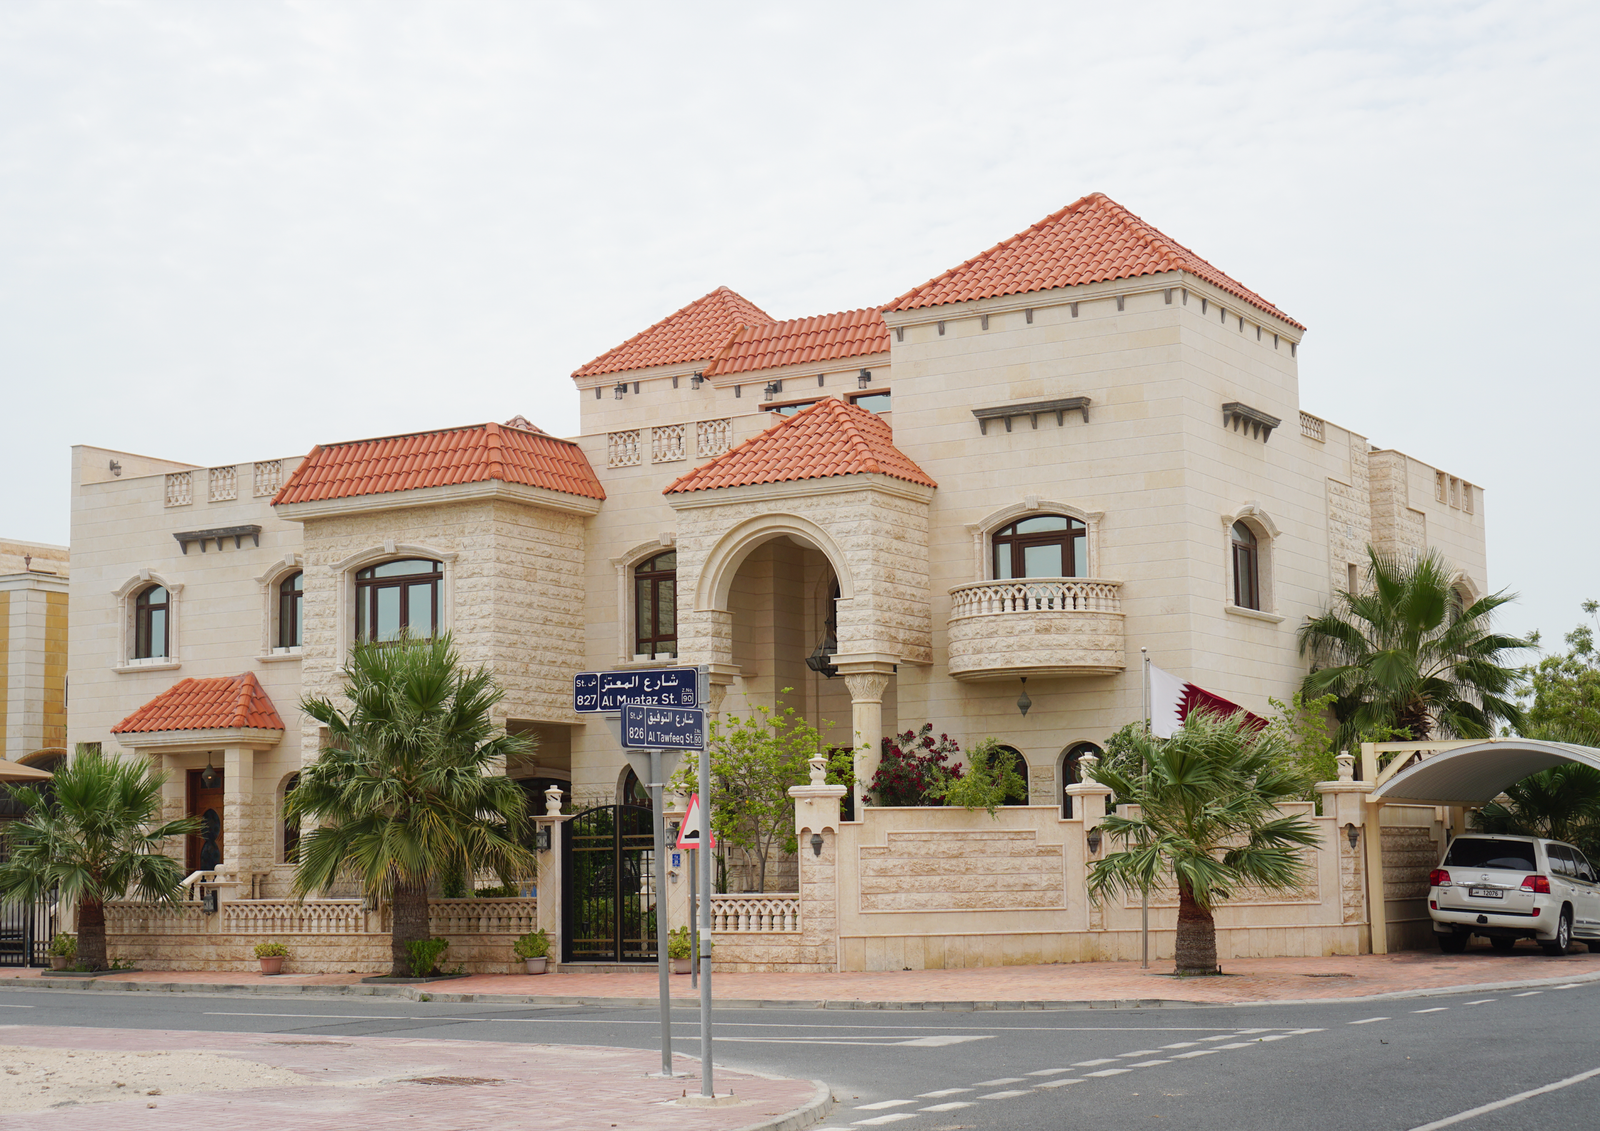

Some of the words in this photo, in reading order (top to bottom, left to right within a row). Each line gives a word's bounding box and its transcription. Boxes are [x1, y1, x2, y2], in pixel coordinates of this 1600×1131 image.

[576, 679, 587, 687] St.
[588, 678, 597, 687] ش
[601, 675, 639, 692] المعتز
[644, 674, 679, 692] شارع
[577, 694, 597, 706] 827
[601, 695, 613, 706] Al
[617, 694, 658, 706] Muataz
[661, 693, 678, 704] St.
[647, 710, 672, 725] التوفيق
[675, 713, 694, 727] شارع
[629, 727, 644, 739] 826
[648, 731, 655, 742] Al
[656, 731, 684, 744] Tawfeeq
[685, 733, 694, 743] St.
